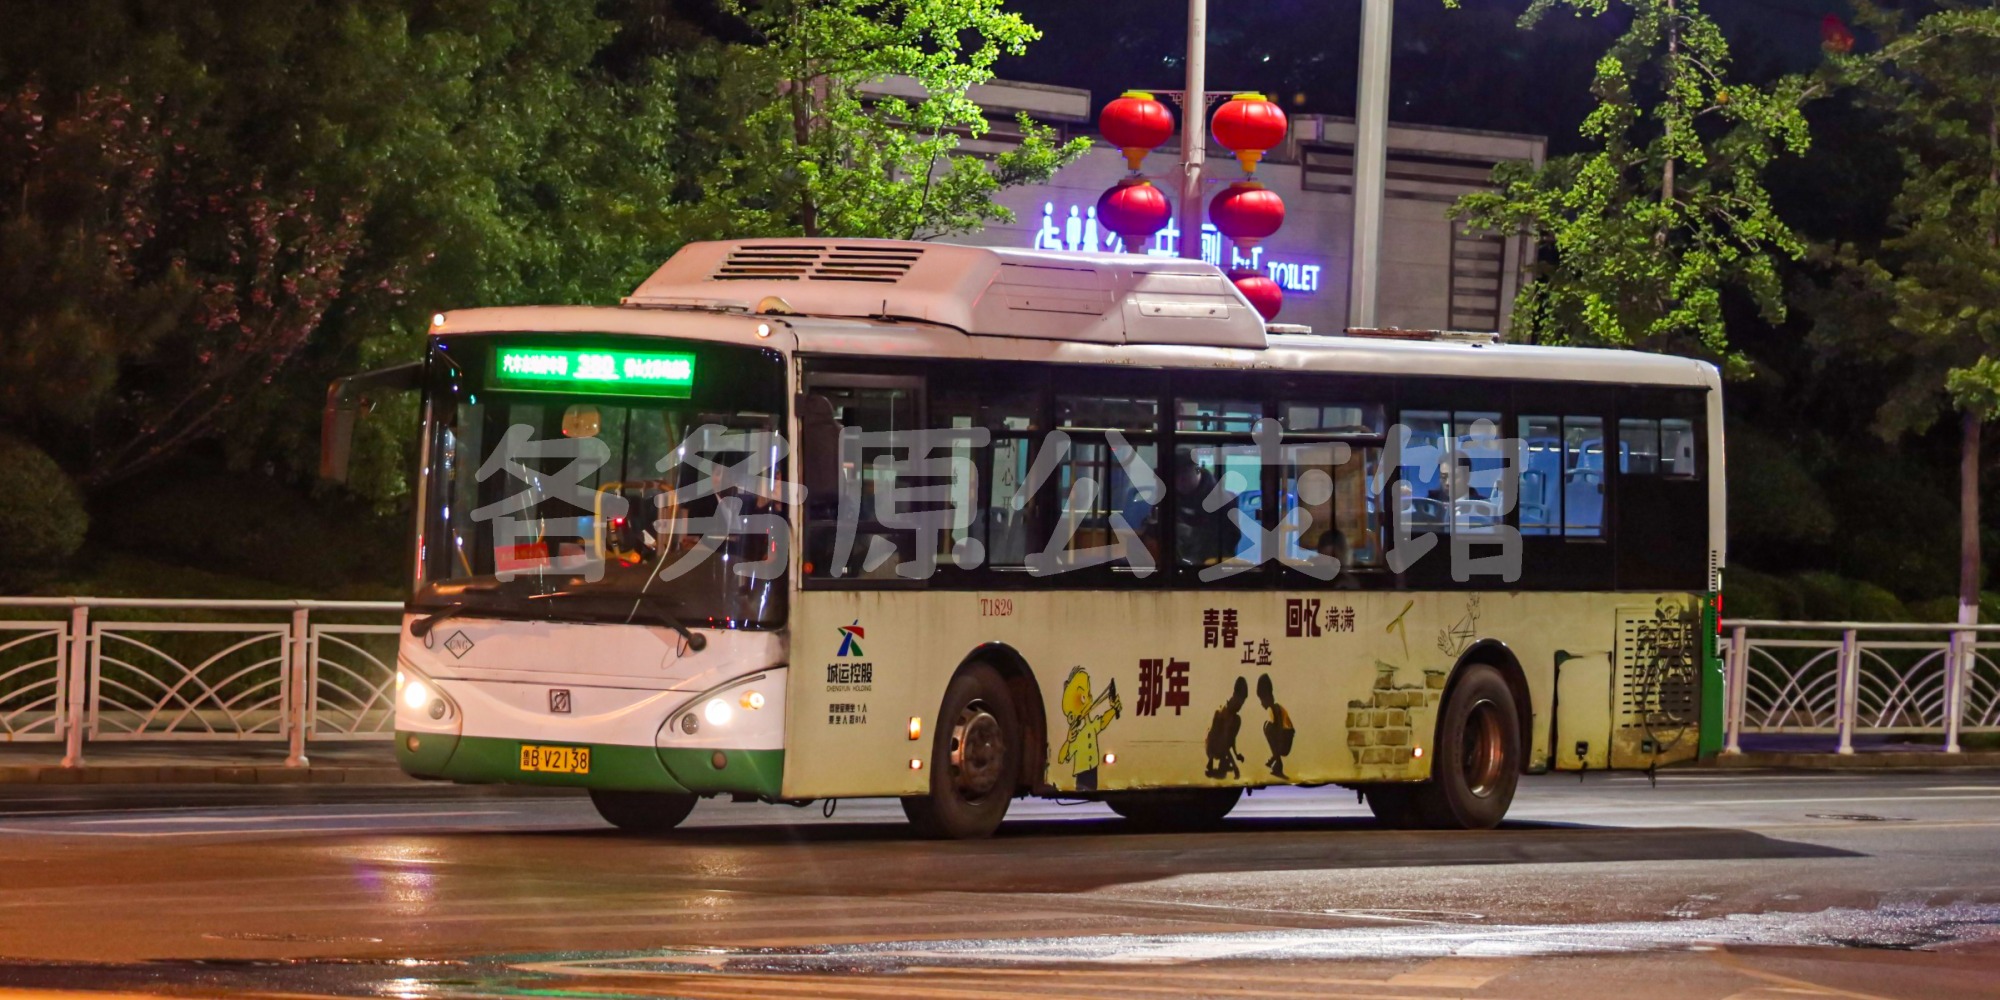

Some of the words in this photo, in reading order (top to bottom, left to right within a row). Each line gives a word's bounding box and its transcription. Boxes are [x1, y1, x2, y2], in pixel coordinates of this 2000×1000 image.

[1267, 261, 1320, 291] TOILET
[980, 599, 1013, 616] T1829
[1285, 598, 1321, 638] 回忆
[1325, 606, 1356, 633] 满满
[1203, 608, 1239, 649] 青春
[449, 640, 468, 650] CNG
[1241, 638, 1272, 666] 正盛
[826, 662, 873, 684] 城运控股
[1136, 657, 1190, 717] 那年
